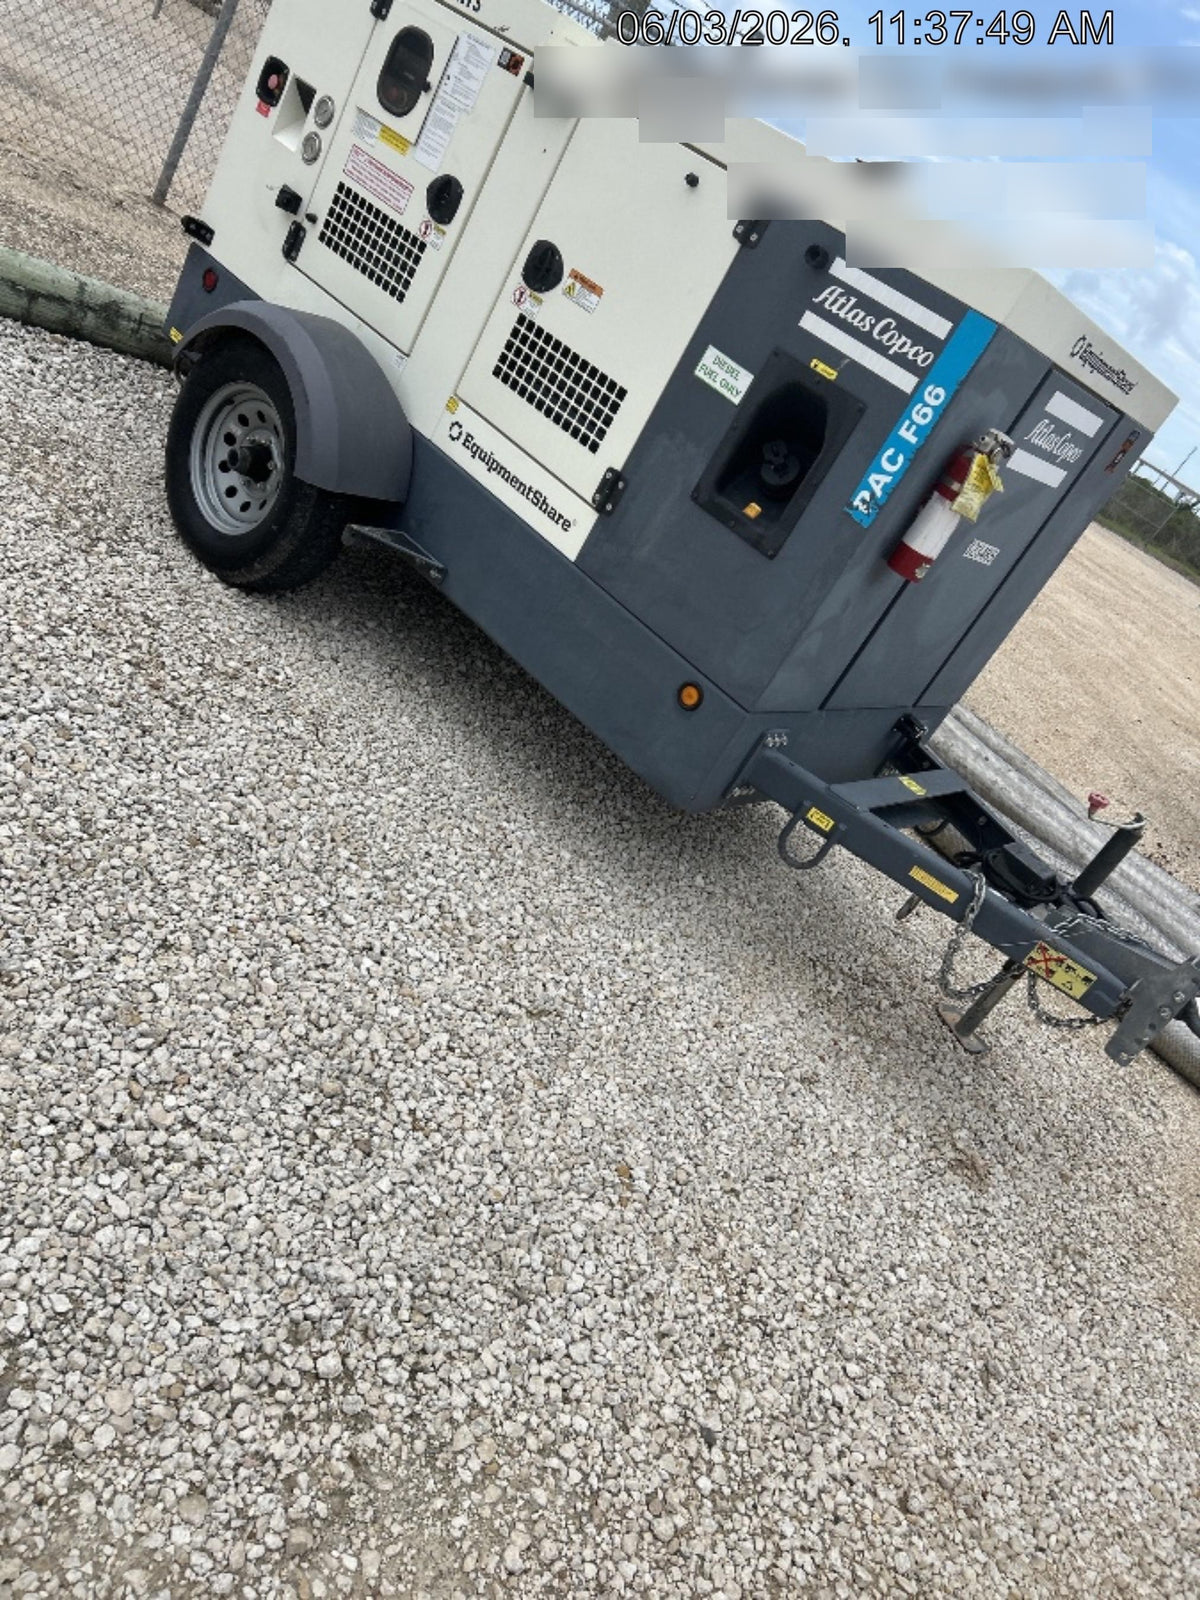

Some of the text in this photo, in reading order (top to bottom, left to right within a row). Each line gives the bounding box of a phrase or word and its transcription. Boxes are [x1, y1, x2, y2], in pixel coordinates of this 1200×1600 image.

[812, 285, 935, 368] Atlas Copco
[698, 364, 742, 398] FUEL ONLY
[712, 355, 741, 381] DIESEL
[853, 384, 947, 515] PAC F66
[1024, 419, 1060, 453] Atlas
[461, 431, 573, 533] EquipmentShare
